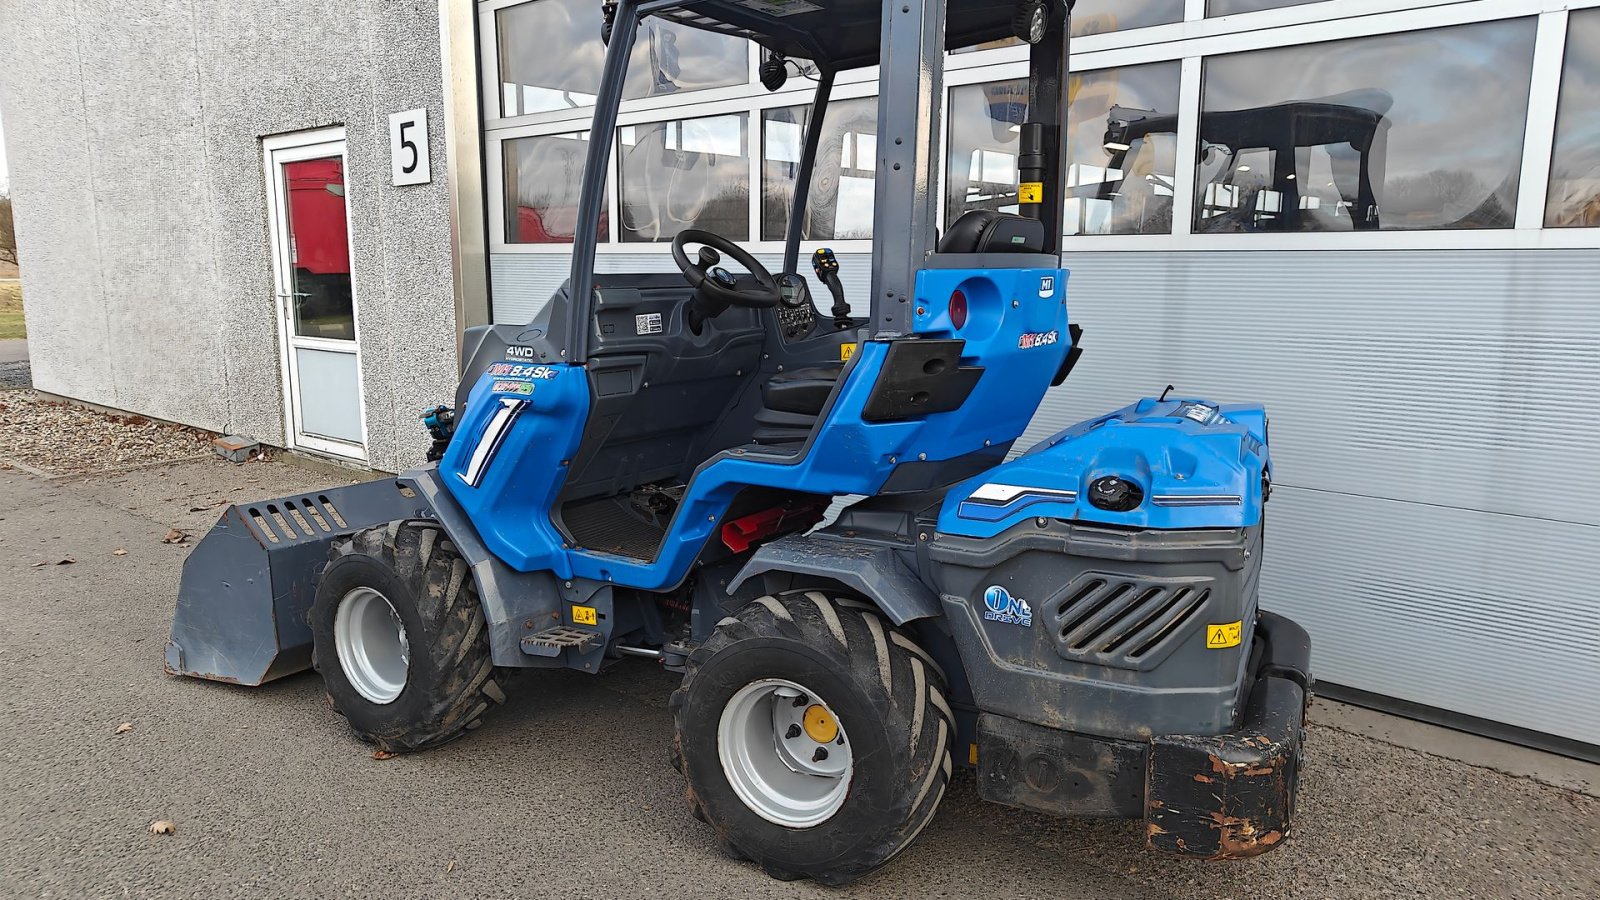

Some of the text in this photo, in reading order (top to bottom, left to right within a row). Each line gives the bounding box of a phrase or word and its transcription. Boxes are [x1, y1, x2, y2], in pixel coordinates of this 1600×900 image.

[400, 121, 418, 173] 5
[506, 346, 534, 356] 4WD
[985, 611, 1031, 627] DRIVE
